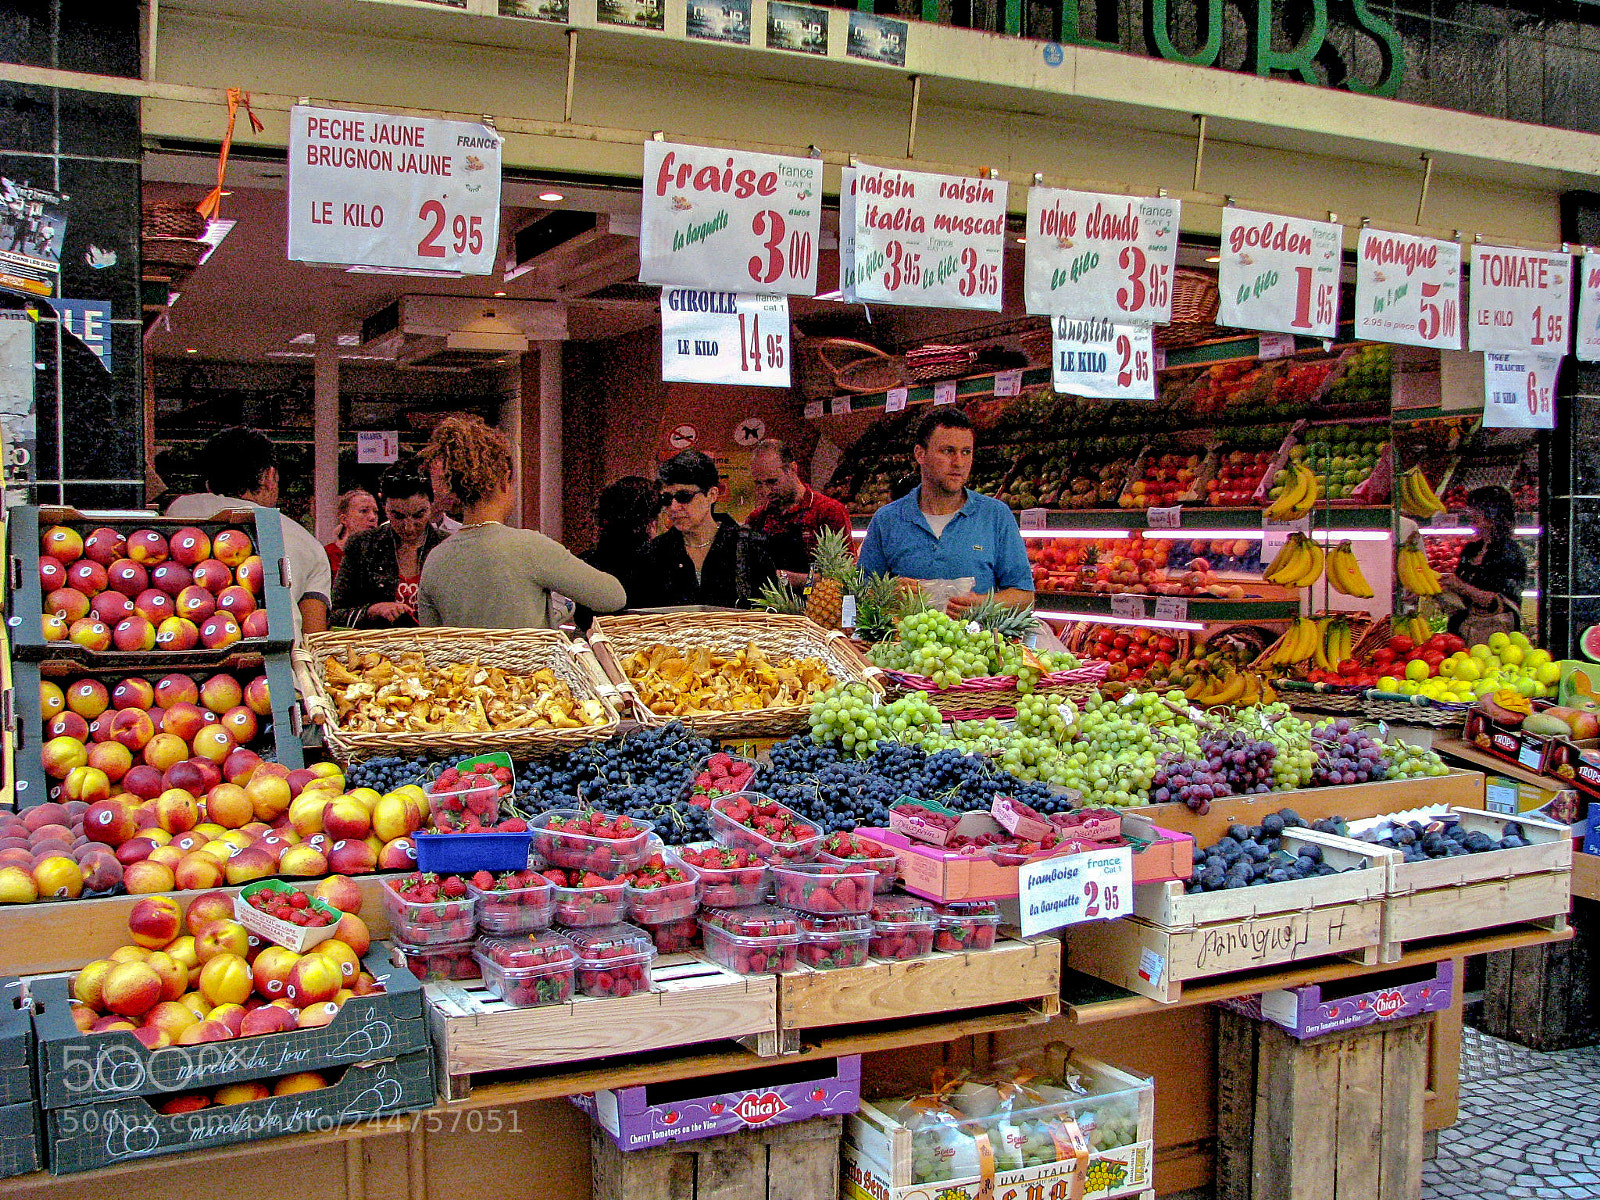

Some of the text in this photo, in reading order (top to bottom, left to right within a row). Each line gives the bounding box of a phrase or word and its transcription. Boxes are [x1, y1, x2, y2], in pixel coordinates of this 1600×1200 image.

[308, 116, 425, 148] PECHE JAUNE
[456, 135, 497, 150] FRANCE
[307, 144, 452, 177] BRUGNON JAUNE
[656, 151, 778, 199] fraise
[778, 163, 814, 179] france
[860, 171, 994, 204] raisin raisin
[311, 201, 384, 228] LE KILO
[864, 203, 1004, 235] italia muscat
[1039, 198, 1139, 242] reine claude
[1140, 203, 1173, 218] france
[417, 199, 483, 258] 2 95
[672, 208, 729, 252] la barquette
[1229, 221, 1312, 255] golden
[748, 209, 812, 284] 3 00
[1365, 236, 1437, 276] mangue
[866, 250, 884, 281] kilo
[883, 240, 921, 292] 3 95
[922, 267, 934, 290] le
[958, 247, 998, 297] 3 95
[1050, 251, 1100, 291] le kilo
[1116, 246, 1169, 312] 3 95
[1480, 254, 1548, 289] TOMATE
[668, 289, 738, 315] GIROLLE
[1236, 269, 1279, 305] le kilo
[1290, 266, 1333, 328] 1 95
[1418, 282, 1456, 340] 5 00
[1478, 309, 1513, 327] LE KILO
[1530, 305, 1562, 345] 1 95
[677, 339, 719, 357] LE KILO
[738, 312, 784, 372] 14 95
[1060, 351, 1107, 373] LE KILO
[1116, 334, 1149, 388] 2 95
[1527, 371, 1538, 416] 6
[1494, 734, 1515, 750] TROPS
[1027, 866, 1079, 890] framboise
[1087, 857, 1121, 869] france
[1029, 894, 1080, 916] la barquette
[1083, 880, 1120, 917] 2 95
[1376, 993, 1401, 1013] Chica's
[247, 1041, 269, 1068] du
[271, 1041, 311, 1072] jour
[259, 1100, 281, 1127] du
[282, 1101, 323, 1132] jour
[741, 1097, 780, 1119] Chica's
[630, 1120, 717, 1144] Cherry Tomatoes on the Vine
[1001, 1173, 1026, 1187] UVA
